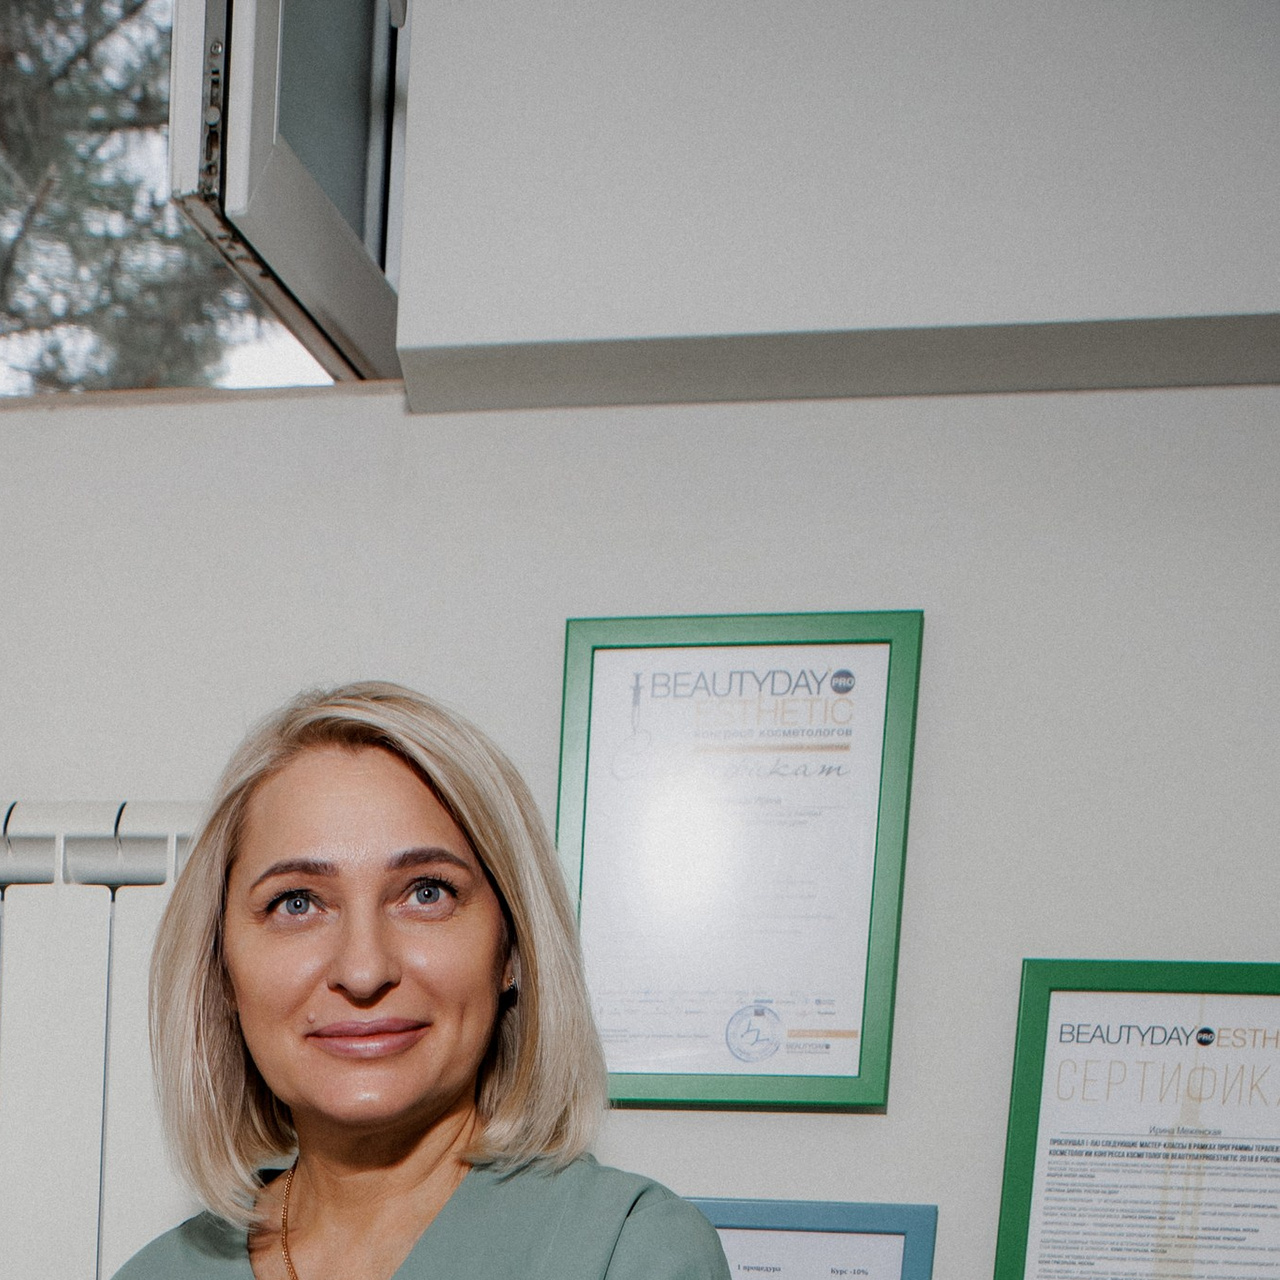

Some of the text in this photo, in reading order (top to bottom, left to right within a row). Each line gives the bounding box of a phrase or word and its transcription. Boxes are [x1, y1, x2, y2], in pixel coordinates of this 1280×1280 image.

[651, 669, 829, 698] BEAUTYDAY
[759, 728, 853, 738] косметологов
[1059, 1023, 1197, 1047] BEAUTYDAY
[1197, 1032, 1215, 1041] PRO
[1056, 1059, 1280, 1106] СЕРТИФИК
